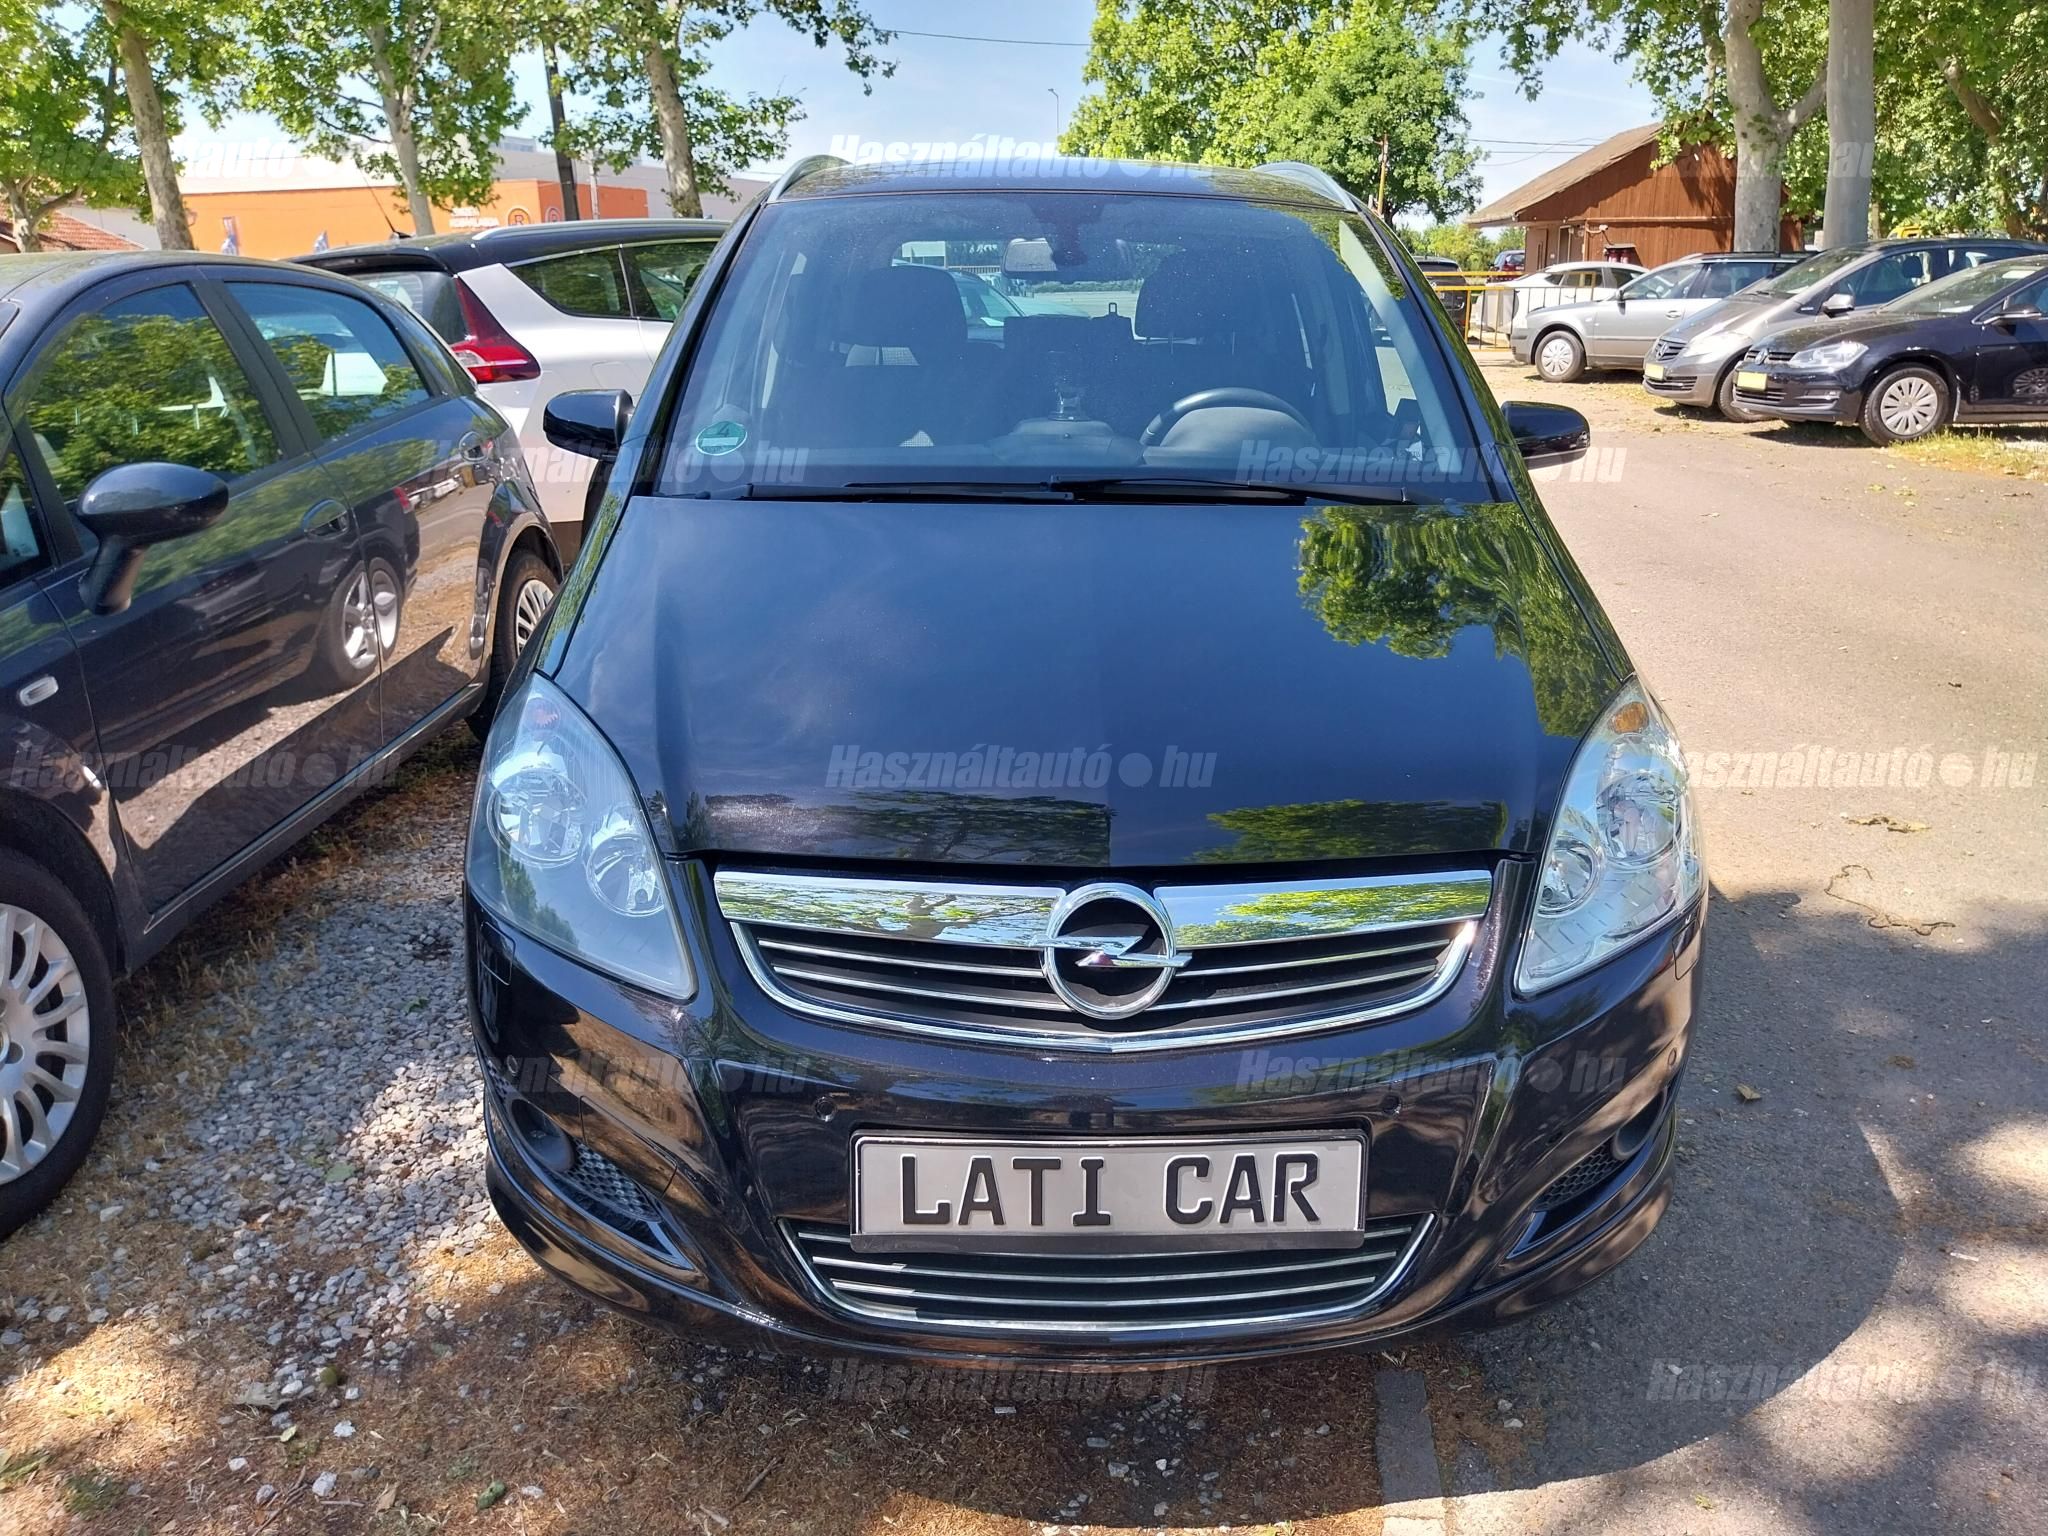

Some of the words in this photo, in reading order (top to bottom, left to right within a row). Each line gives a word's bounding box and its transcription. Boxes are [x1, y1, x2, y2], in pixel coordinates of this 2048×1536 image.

[717, 422, 730, 437] 4
[901, 1154, 1111, 1226] LATI
[1164, 1151, 1320, 1224] CAR
